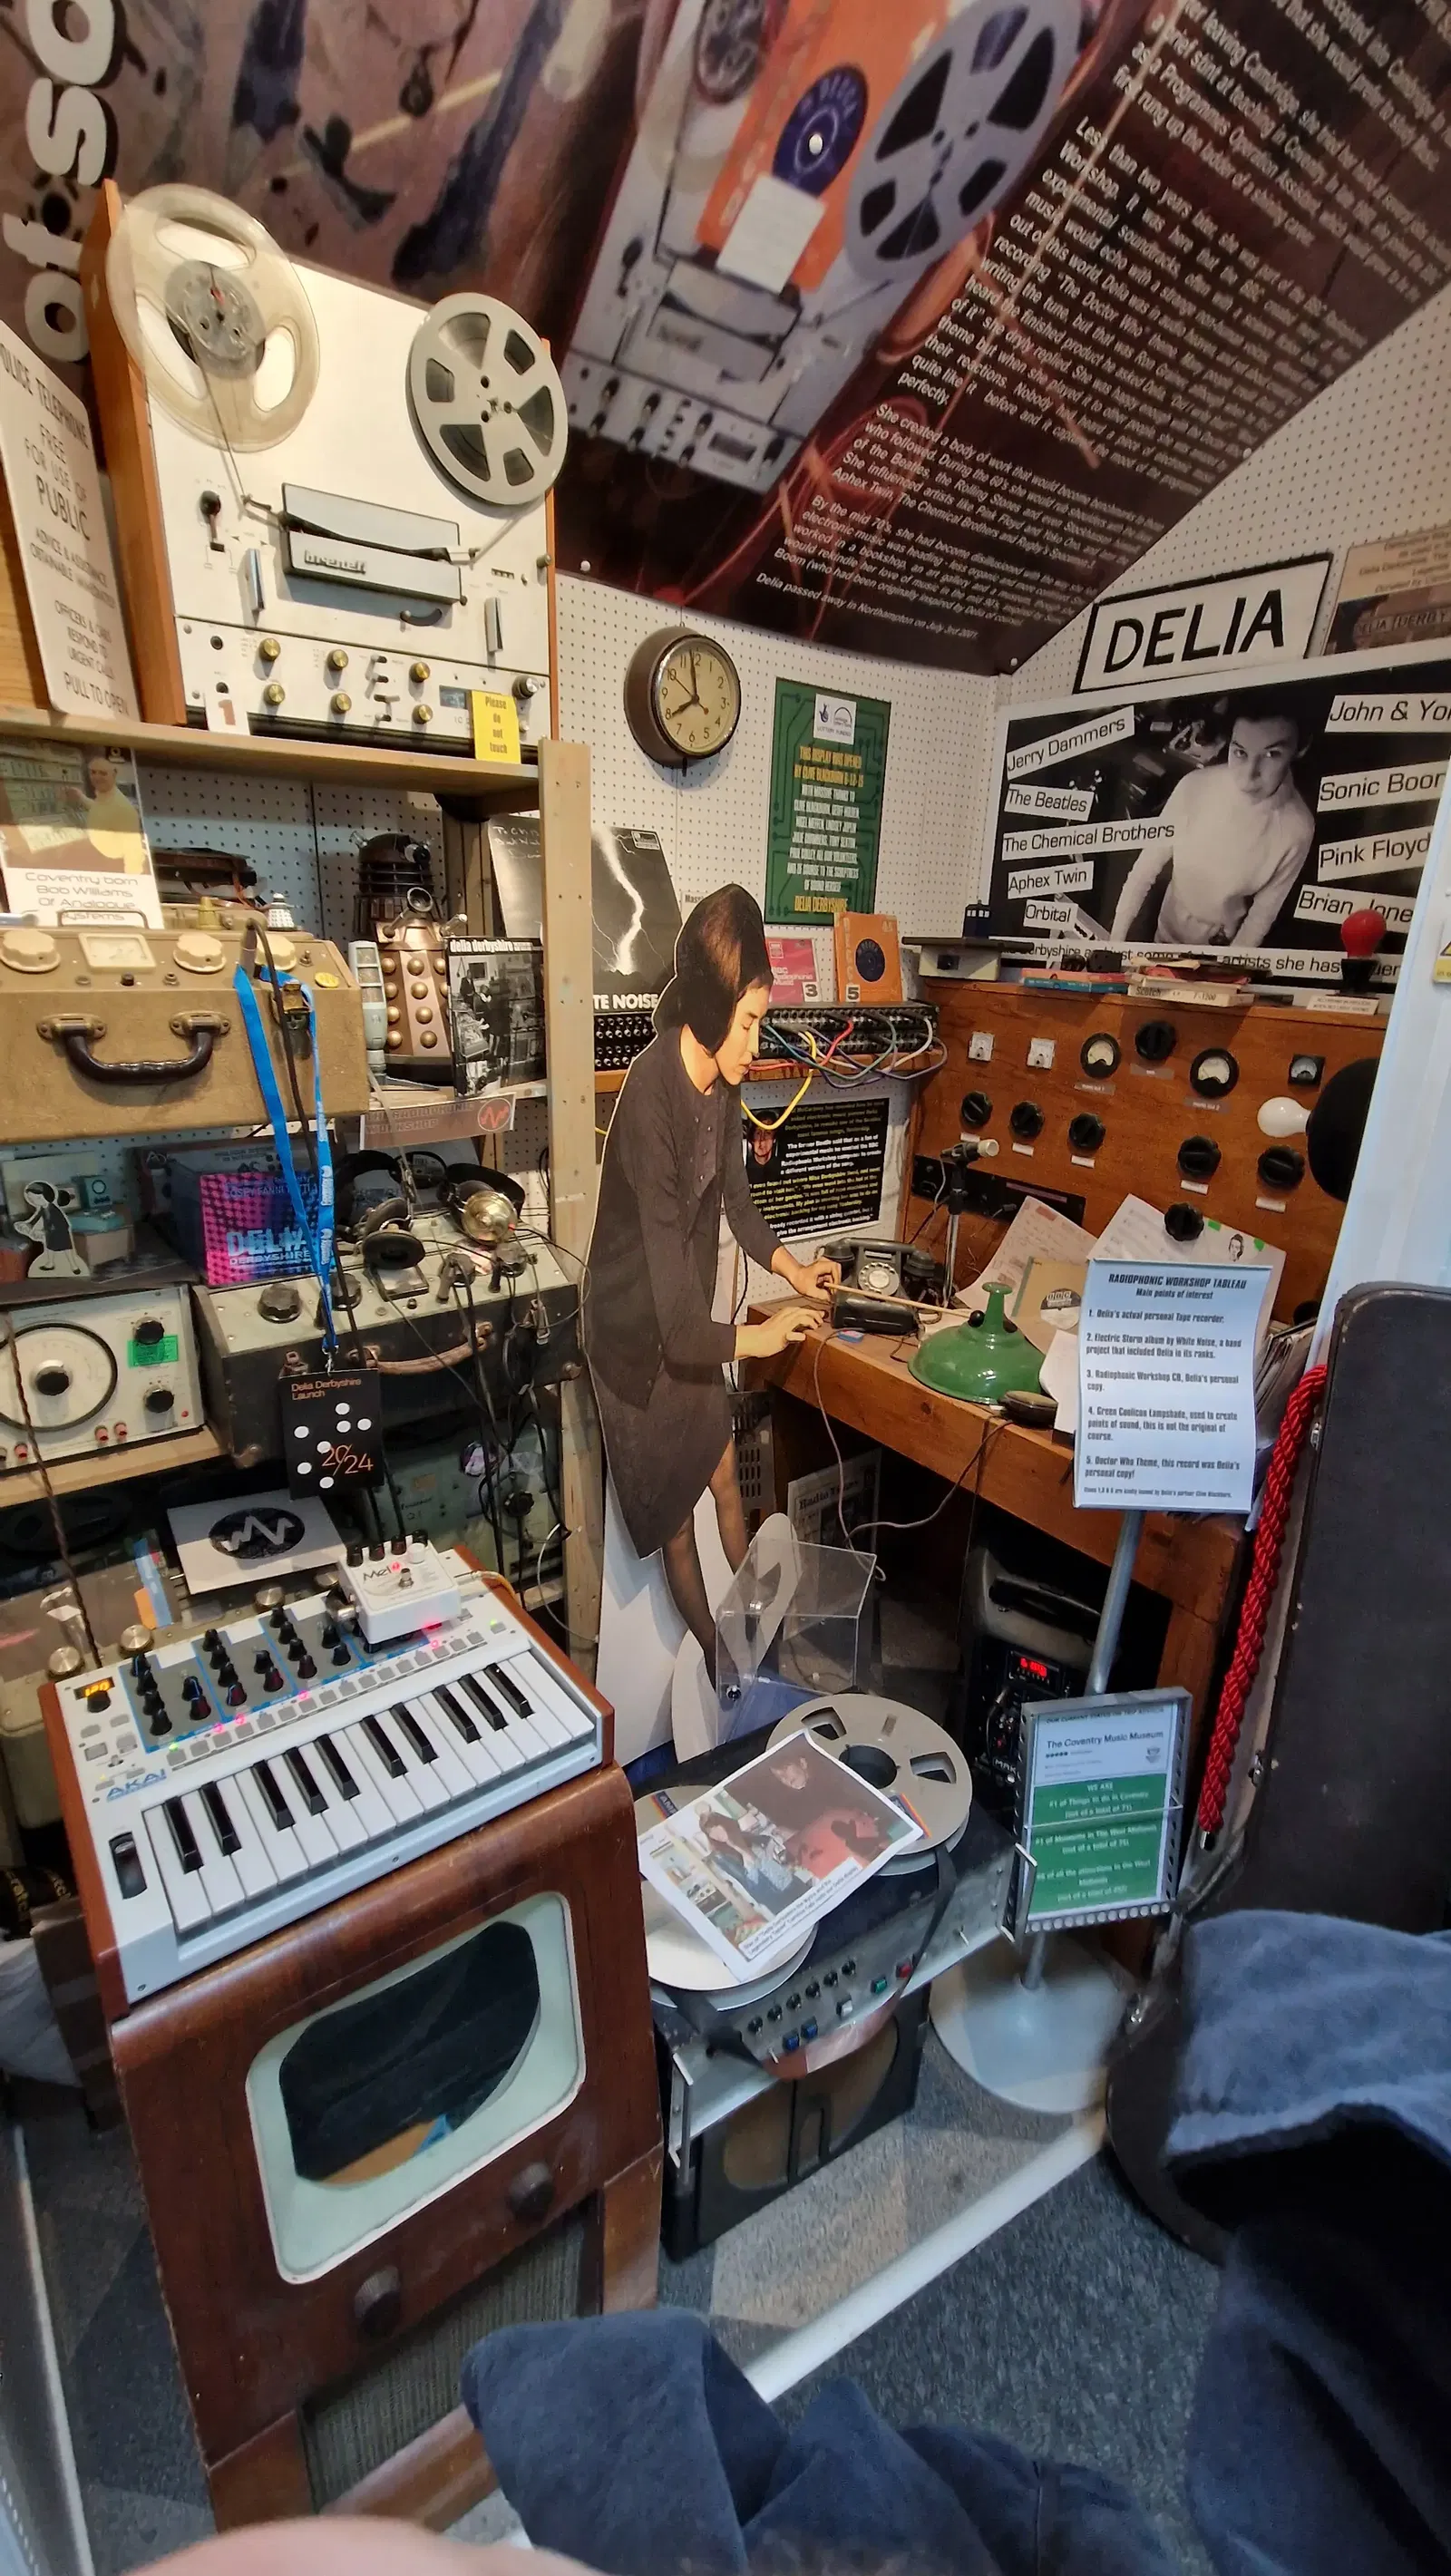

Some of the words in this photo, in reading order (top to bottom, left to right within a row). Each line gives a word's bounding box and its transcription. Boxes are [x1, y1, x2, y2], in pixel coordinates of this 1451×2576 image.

[939, 315, 975, 345] theme
[925, 334, 953, 358] their
[912, 354, 941, 377] quite
[942, 367, 963, 388] like
[984, 390, 1018, 415] before
[0, 344, 33, 396] OLICE
[35, 377, 90, 451] TELEPHONE
[876, 403, 899, 423] She
[901, 418, 942, 442] created
[949, 438, 977, 460] body
[39, 423, 65, 464] FREE
[865, 422, 889, 441] who
[939, 453, 973, 478] During
[25, 437, 47, 475] FOR
[853, 438, 870, 450] of
[870, 443, 889, 459] the
[954, 479, 988, 501] Rolling
[833, 467, 868, 490] Aphex
[842, 452, 865, 470] She
[923, 488, 955, 505] artists
[35, 474, 91, 542] PUBLIC
[812, 495, 830, 510] By
[830, 500, 848, 517] the
[849, 511, 872, 524] mid
[793, 524, 833, 544] worked
[802, 510, 855, 537] electronic
[855, 530, 886, 547] music
[774, 548, 806, 567] Boom
[833, 568, 854, 580] had
[818, 549, 858, 568] rekindle
[878, 567, 899, 580] love
[756, 572, 784, 589] Delia
[783, 582, 822, 599] passed
[821, 590, 847, 608] away
[1103, 588, 1285, 674] DELIA
[717, 676, 724, 689] 2
[63, 671, 90, 699] PULL
[90, 684, 103, 705] TO
[104, 690, 130, 716] OPEN
[662, 687, 667, 699] 9
[485, 695, 507, 709] Please
[721, 697, 726, 709] 3
[218, 699, 236, 726] 1
[1329, 701, 1384, 722] John
[1390, 701, 1408, 721] &
[677, 724, 682, 735] 7
[715, 716, 721, 727] 4
[492, 729, 503, 738] not
[689, 731, 695, 742] 6
[704, 727, 710, 739] 5
[490, 743, 508, 753] touch
[1008, 749, 1045, 772] Jerry
[1048, 717, 1125, 757] Dammers
[1320, 777, 1380, 802] Sonic
[1008, 788, 1032, 806] The
[1034, 792, 1087, 812] Beatles
[1003, 837, 1027, 852] The
[1031, 829, 1098, 850] Chemical
[1102, 823, 1174, 843] Brothers
[1320, 848, 1365, 869] Pink
[1372, 831, 1431, 861] Floyd
[25, 872, 100, 885] Coventry
[103, 875, 138, 885] born
[1008, 875, 1050, 893] Aphex
[1054, 869, 1087, 885] Twin
[36, 885, 70, 895] Bob
[73, 886, 133, 898] Williams
[794, 895, 812, 912] DELIA
[1298, 890, 1353, 915] Brian
[58, 911, 124, 921] ystems
[1025, 904, 1072, 923] Orbital
[450, 939, 472, 953] delia
[472, 939, 513, 953] derbyshire
[1276, 956, 1304, 971] she
[1310, 957, 1340, 974] has
[805, 984, 818, 997] 3
[847, 987, 859, 999] 5
[612, 993, 658, 1009] NOISE
[229, 1249, 311, 1265] DERBYSHIRE
[1108, 1274, 1164, 1286] RADIOPHONIC
[1165, 1277, 1211, 1288] WORKSHOP
[1213, 1278, 1247, 1289] TABLEAU
[1135, 1288, 1153, 1297] Main
[1154, 1288, 1175, 1298] points
[1177, 1290, 1184, 1298] of
[1186, 1291, 1213, 1299] interest
[1096, 1309, 1120, 1318] Delia's
[1122, 1311, 1143, 1320] actual
[1144, 1313, 1173, 1321] personal
[1176, 1314, 1191, 1322] Tape
[1095, 1333, 1120, 1343] Electric
[1122, 1335, 1143, 1344] Storm
[1144, 1336, 1164, 1344] album
[1166, 1337, 1173, 1346] by
[1176, 1337, 1194, 1346] White
[1086, 1346, 1110, 1356] project
[1112, 1346, 1125, 1355] that
[1126, 1346, 1154, 1356] included
[1157, 1348, 1173, 1357] Delia
[1194, 1350, 1215, 1358] ranks.
[291, 1381, 314, 1392] Delia
[316, 1378, 362, 1389] Derbyshire
[1096, 1370, 1135, 1381] Radiophonic
[1136, 1372, 1170, 1383] Workshop
[1185, 1374, 1208, 1383] Delia's
[1209, 1375, 1239, 1385] personal
[292, 1389, 325, 1401] Launch
[1087, 1383, 1105, 1392] copy.
[1096, 1406, 1117, 1416] Green
[1118, 1407, 1147, 1417] Coolicon
[1190, 1411, 1205, 1420] used
[1088, 1419, 1108, 1430] points
[1119, 1421, 1142, 1431] sound,
[1143, 1421, 1156, 1430] this
[1166, 1423, 1177, 1431] not
[1179, 1423, 1189, 1431] the
[1191, 1424, 1217, 1434] original
[1087, 1433, 1114, 1441] course.
[1095, 1456, 1118, 1465] Doctor
[1119, 1456, 1134, 1466] Who
[1135, 1457, 1160, 1469] Theme,
[1162, 1459, 1174, 1467] this
[1176, 1460, 1199, 1468] record
[1217, 1461, 1240, 1471] Delia's
[1085, 1469, 1115, 1478] personal
[1047, 1740, 1062, 1748] The
[1065, 1737, 1103, 1747] Coventry
[1105, 1734, 1127, 1743] Music
[1129, 1731, 1164, 1740] Museum
[107, 1769, 167, 1803] AKAI
